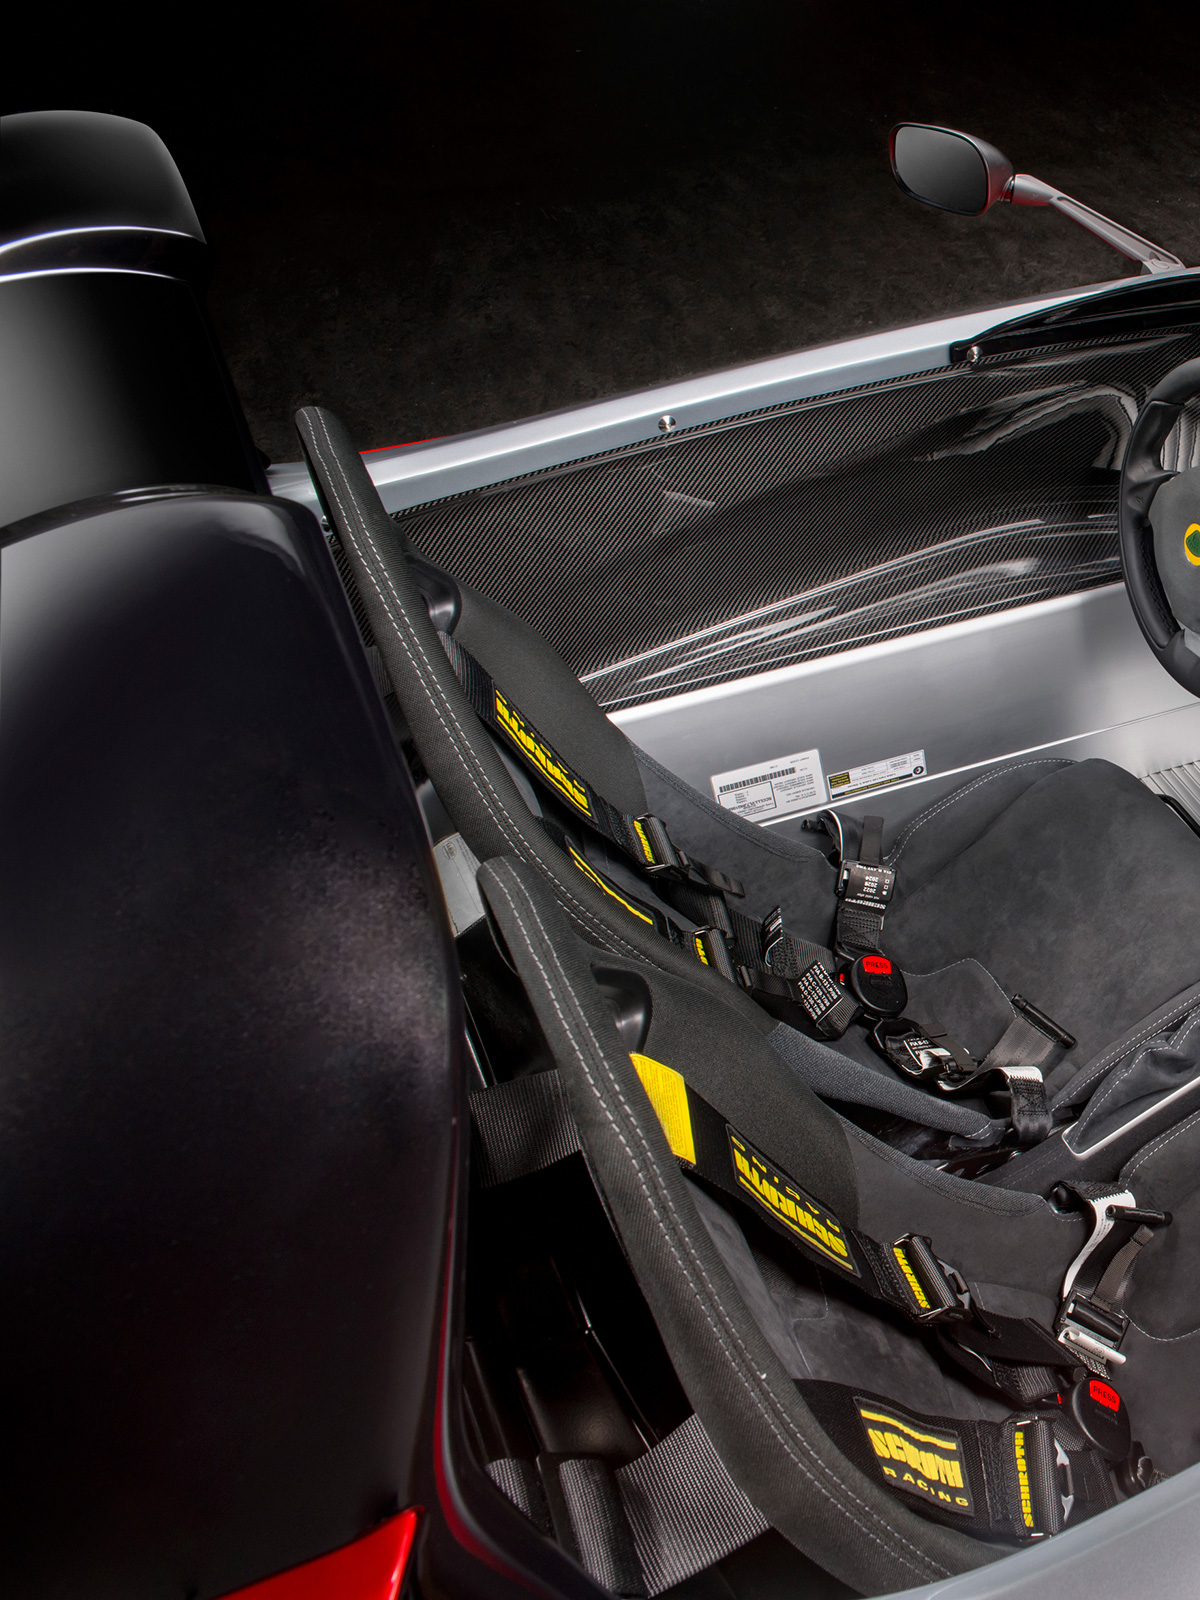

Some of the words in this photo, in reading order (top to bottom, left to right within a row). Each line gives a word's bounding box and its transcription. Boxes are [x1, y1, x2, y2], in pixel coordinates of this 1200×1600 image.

[865, 961, 888, 969] PRESS
[730, 1135, 840, 1233] RACING
[733, 1148, 848, 1257] SCHROTH
[1093, 1385, 1117, 1404] PRESS
[867, 1427, 964, 1488] SCHROTH
[882, 1466, 969, 1506] RACING
[1014, 1431, 1034, 1527] SCHROTH
